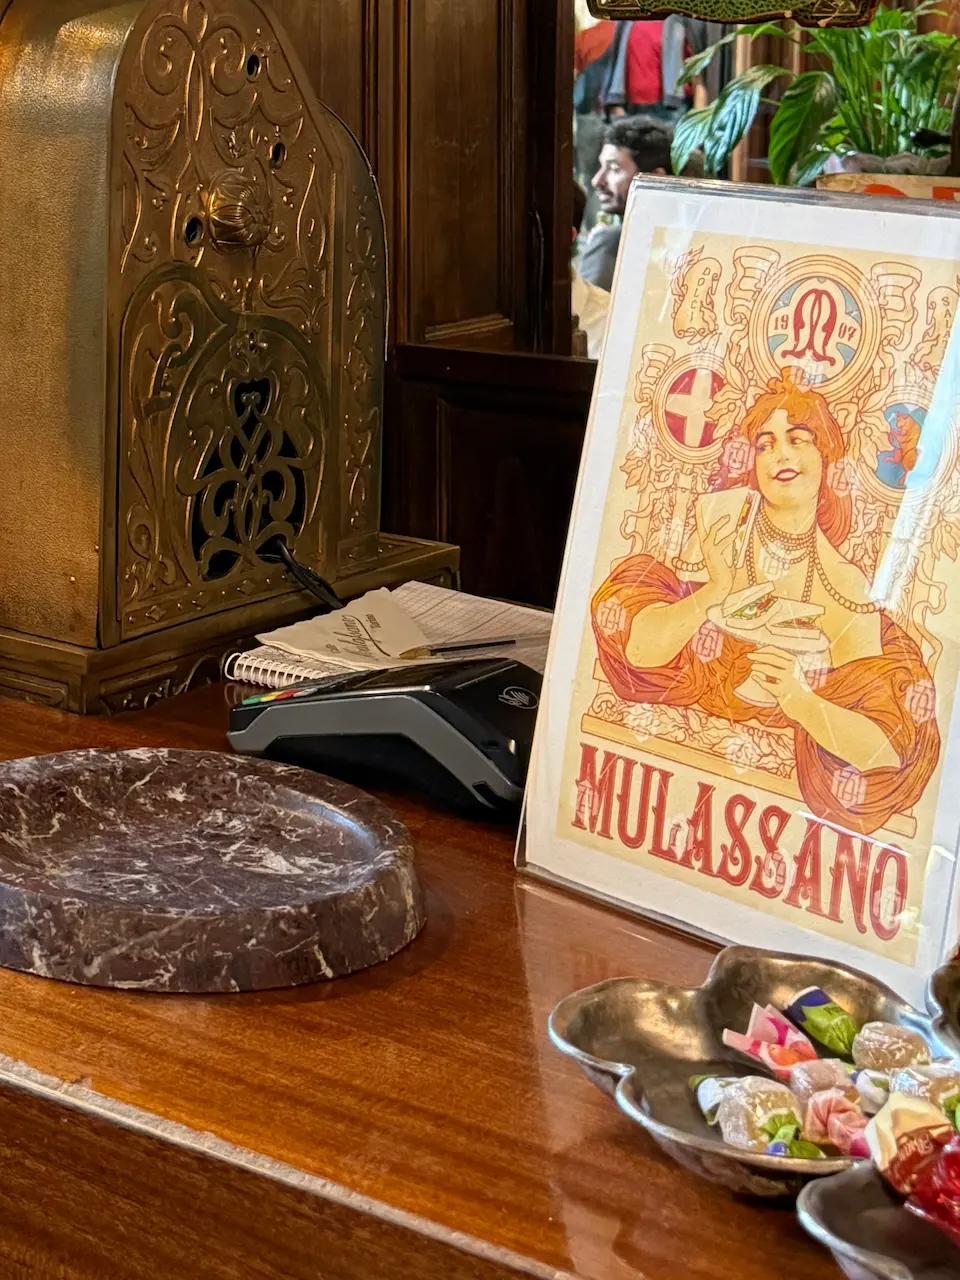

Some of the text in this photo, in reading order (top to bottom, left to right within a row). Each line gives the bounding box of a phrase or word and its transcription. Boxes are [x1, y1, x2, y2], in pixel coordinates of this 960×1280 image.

[690, 266, 712, 322] DOLCI
[774, 317, 789, 331] 19
[839, 322, 857, 342] 07
[571, 742, 908, 941] MULASSANO
